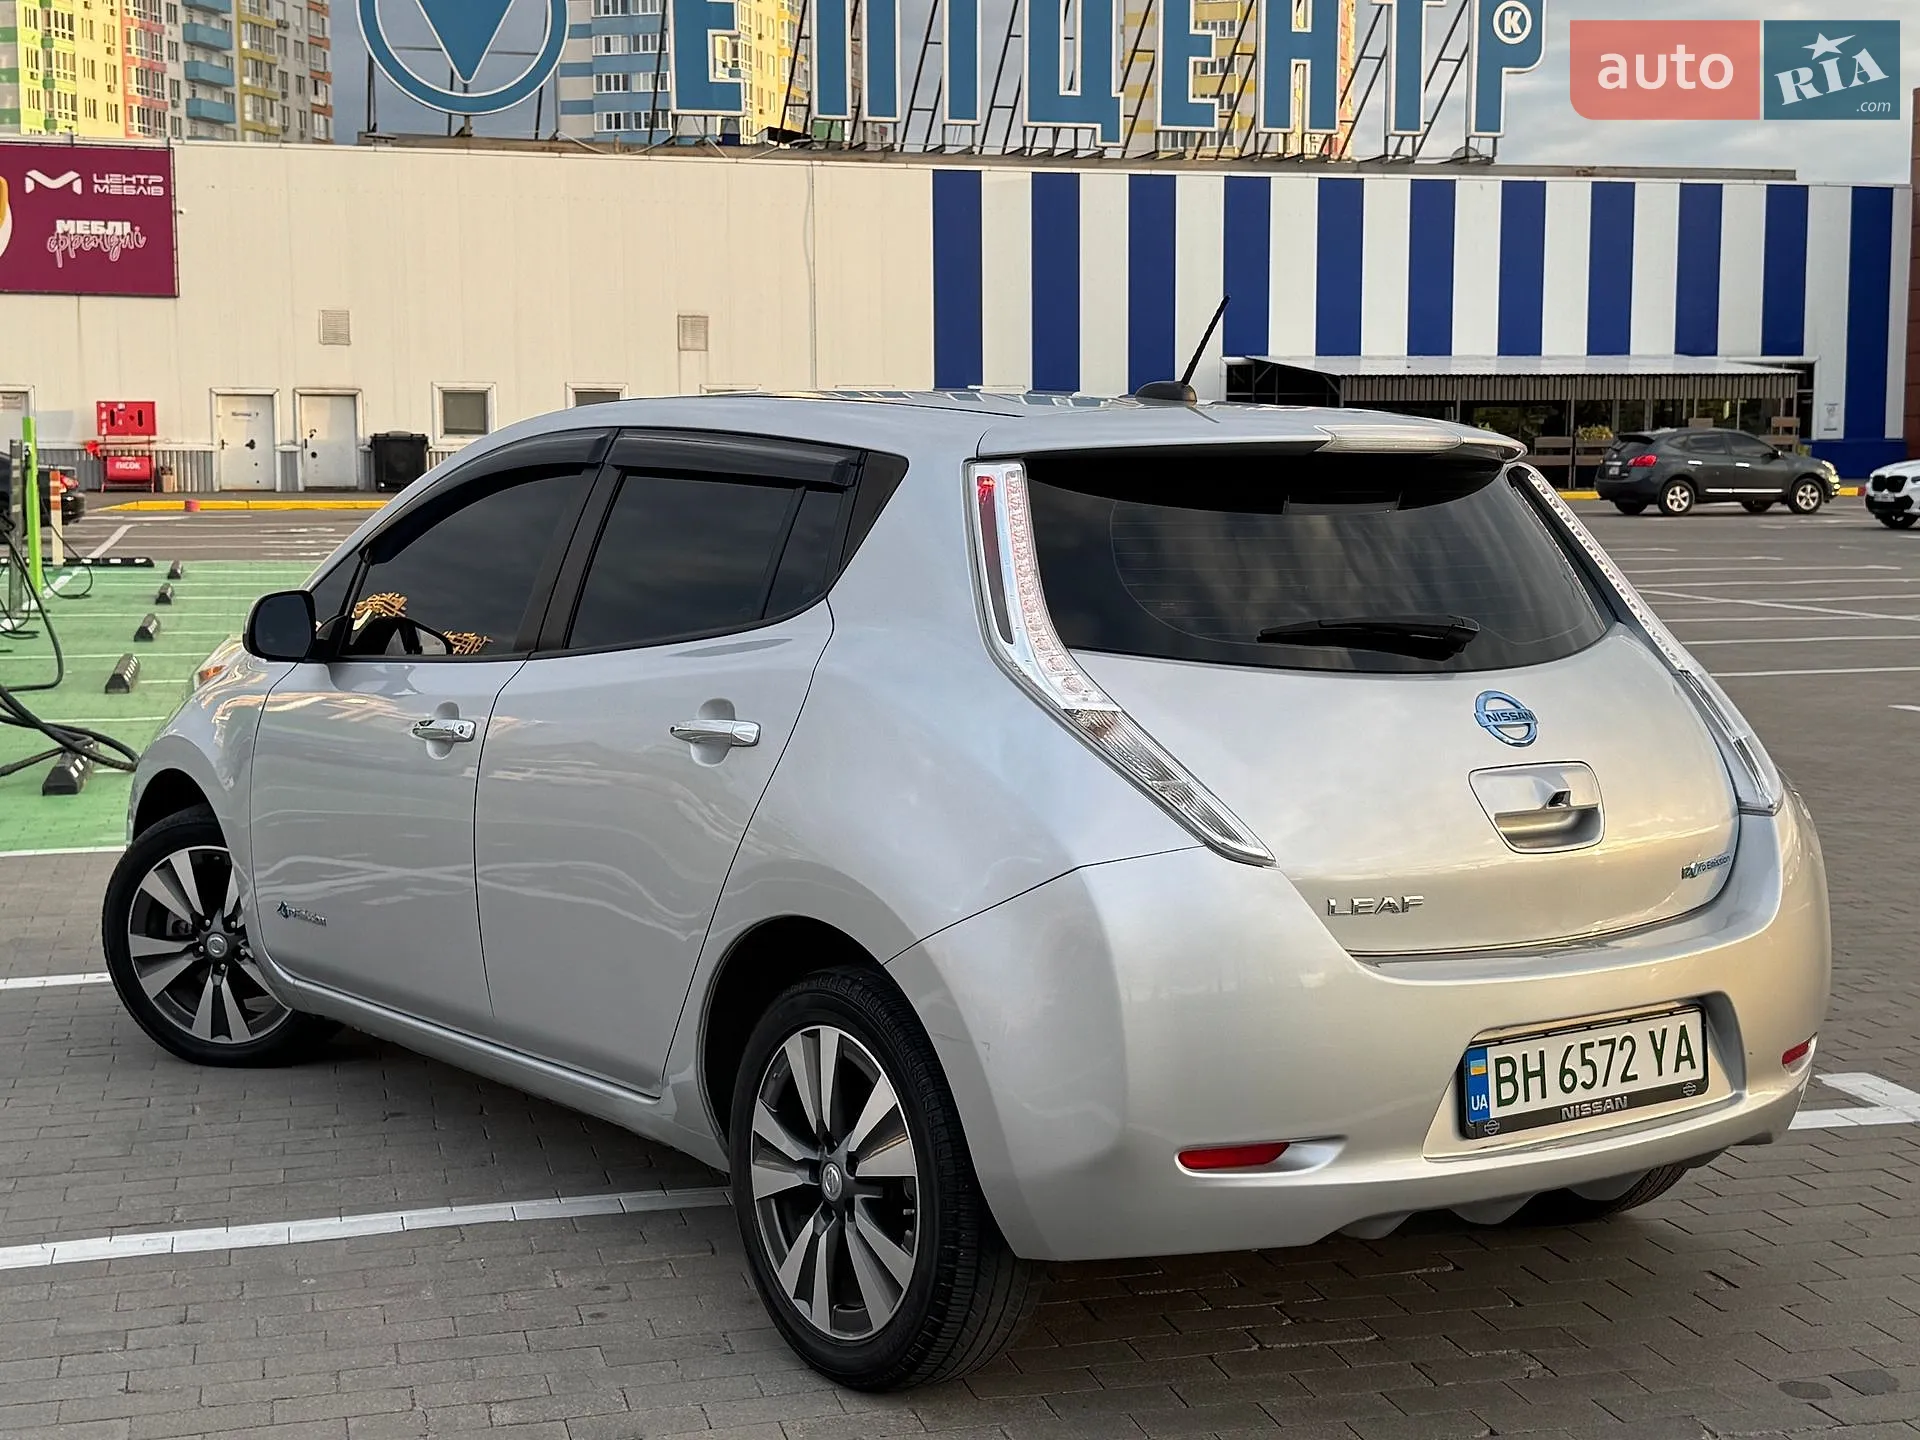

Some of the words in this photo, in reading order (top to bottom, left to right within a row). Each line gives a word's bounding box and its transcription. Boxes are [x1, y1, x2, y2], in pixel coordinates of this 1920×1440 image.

[93, 173, 164, 185] ЦЕНТР
[93, 184, 164, 196] МЕБЛІВ
[56, 219, 132, 235] МЕБЛІ
[1486, 711, 1536, 723] NISSAN
[1327, 895, 1424, 916] LEAF
[1494, 1049, 1548, 1108] BH
[1558, 1035, 1638, 1094] 6572
[1648, 1023, 1697, 1077] YA
[1471, 1093, 1489, 1111] UA
[1560, 1095, 1628, 1121] NISSAN
